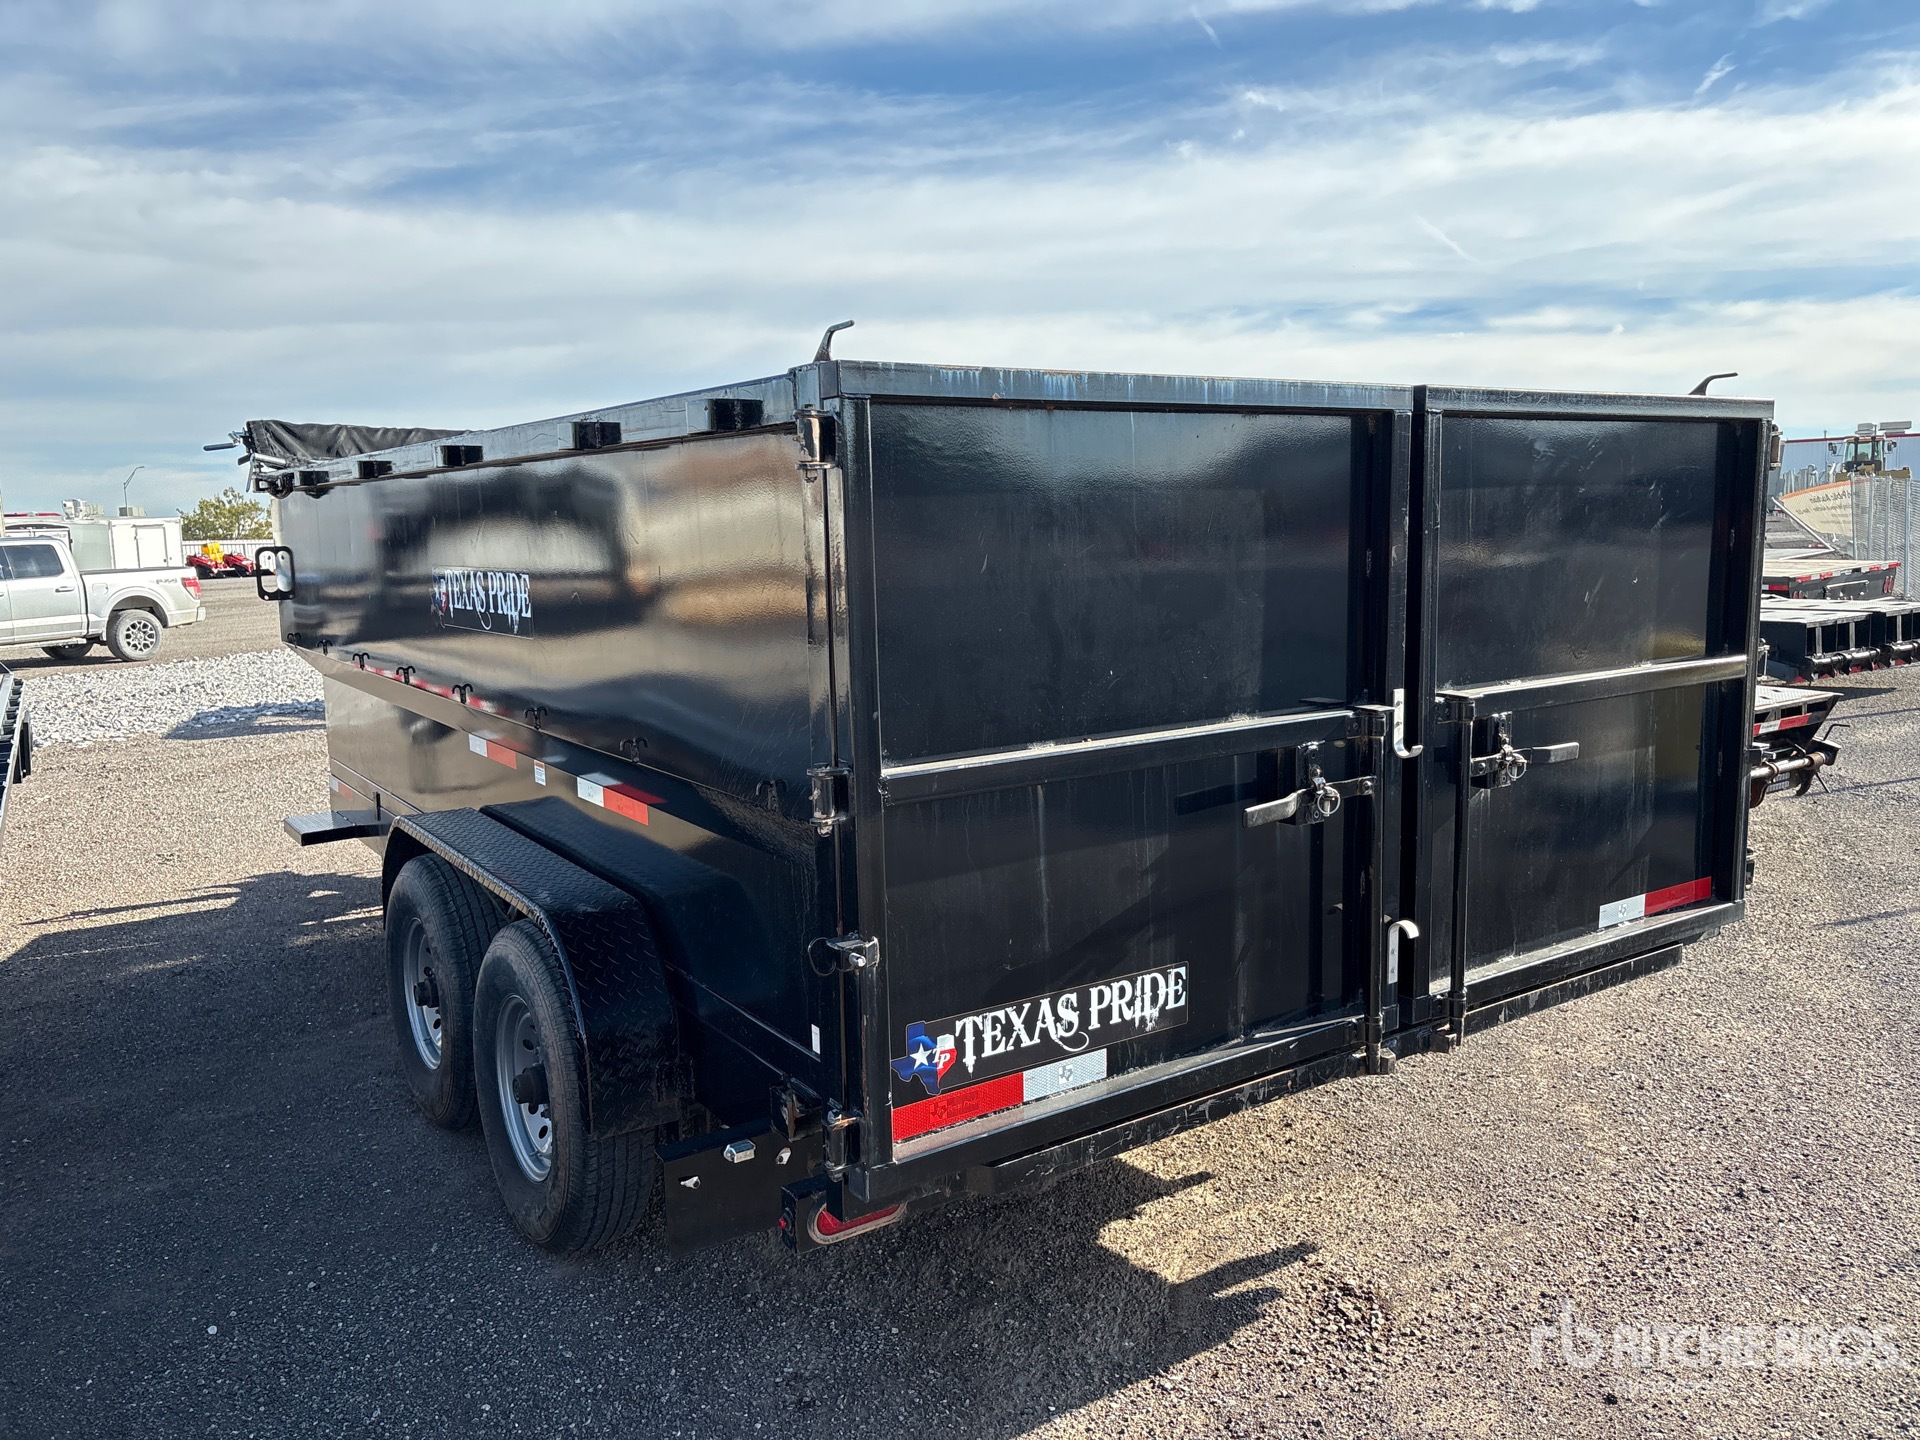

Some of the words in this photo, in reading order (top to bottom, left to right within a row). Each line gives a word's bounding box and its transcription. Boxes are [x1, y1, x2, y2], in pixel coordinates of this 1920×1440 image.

[445, 569, 492, 630] TEXAS
[487, 571, 532, 635] PRIDE
[955, 992, 1090, 1078] TEXAS
[1088, 965, 1187, 1032] PRIDE
[932, 1046, 951, 1070] TP
